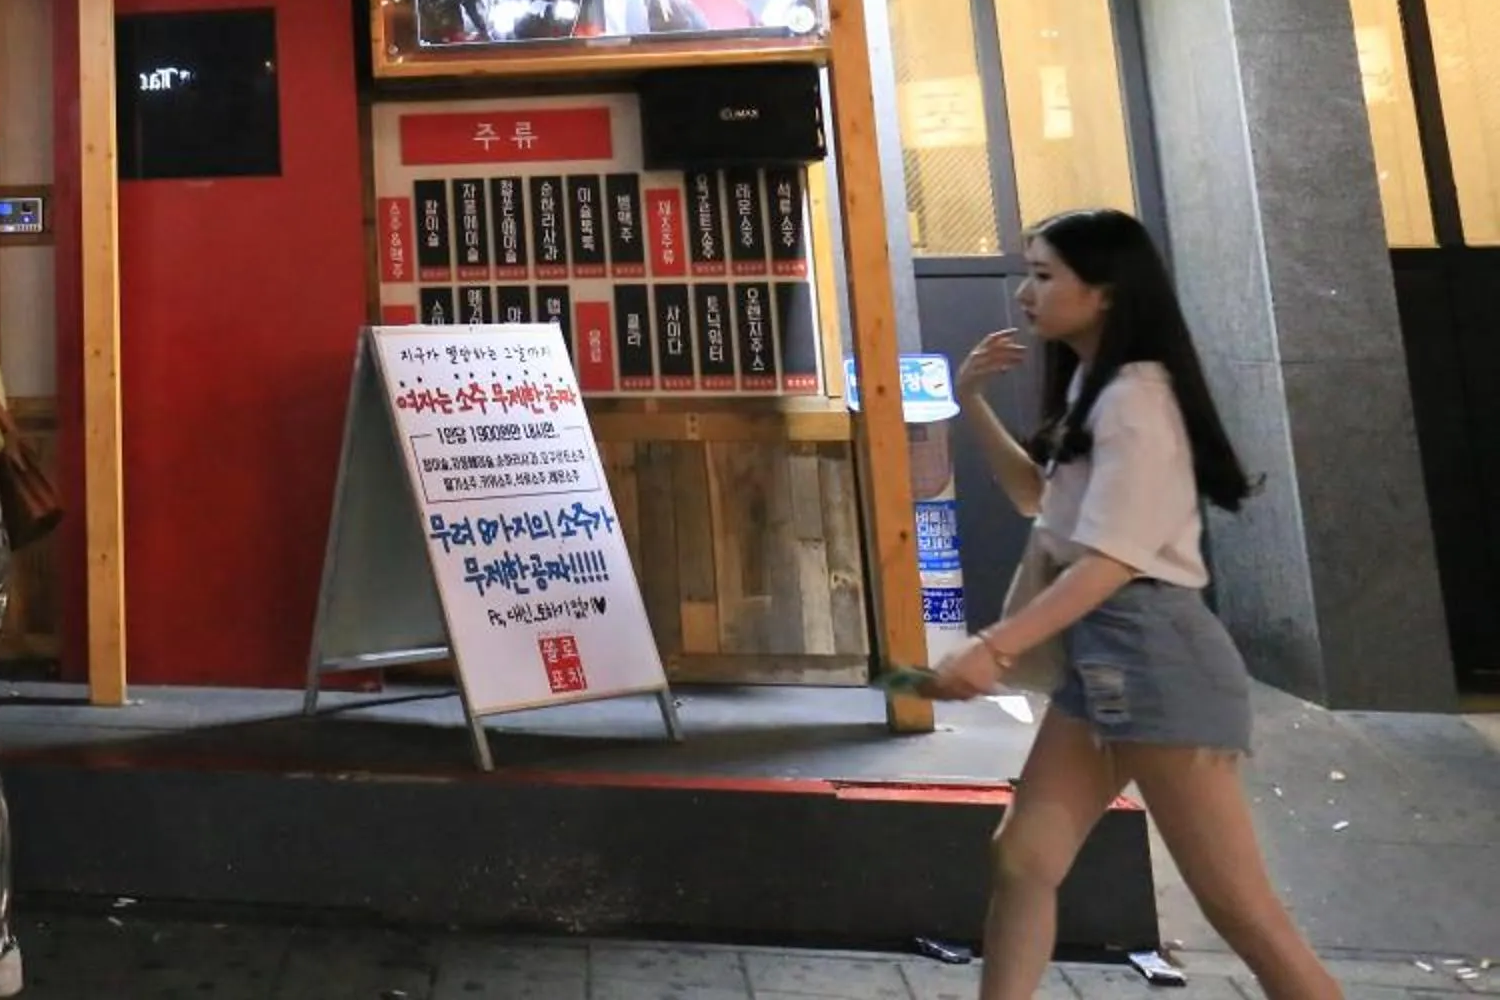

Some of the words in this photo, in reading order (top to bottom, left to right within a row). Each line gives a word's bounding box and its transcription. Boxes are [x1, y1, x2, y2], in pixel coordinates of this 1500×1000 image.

[473, 121, 539, 152] 주류
[425, 200, 440, 247] 참이슬
[540, 181, 558, 261] 순하리사과
[735, 183, 754, 249] 레몬소주
[627, 313, 642, 347] 콜라
[666, 305, 682, 355] 사이다
[707, 296, 724, 361] 토닉워터
[747, 287, 765, 371] 오렌지주스
[400, 347, 440, 365] 지구가
[397, 387, 453, 415] 여자는
[455, 382, 489, 415] 소주
[429, 513, 477, 553] 무려
[477, 510, 557, 546] 8가지의
[557, 502, 615, 541] 소주가
